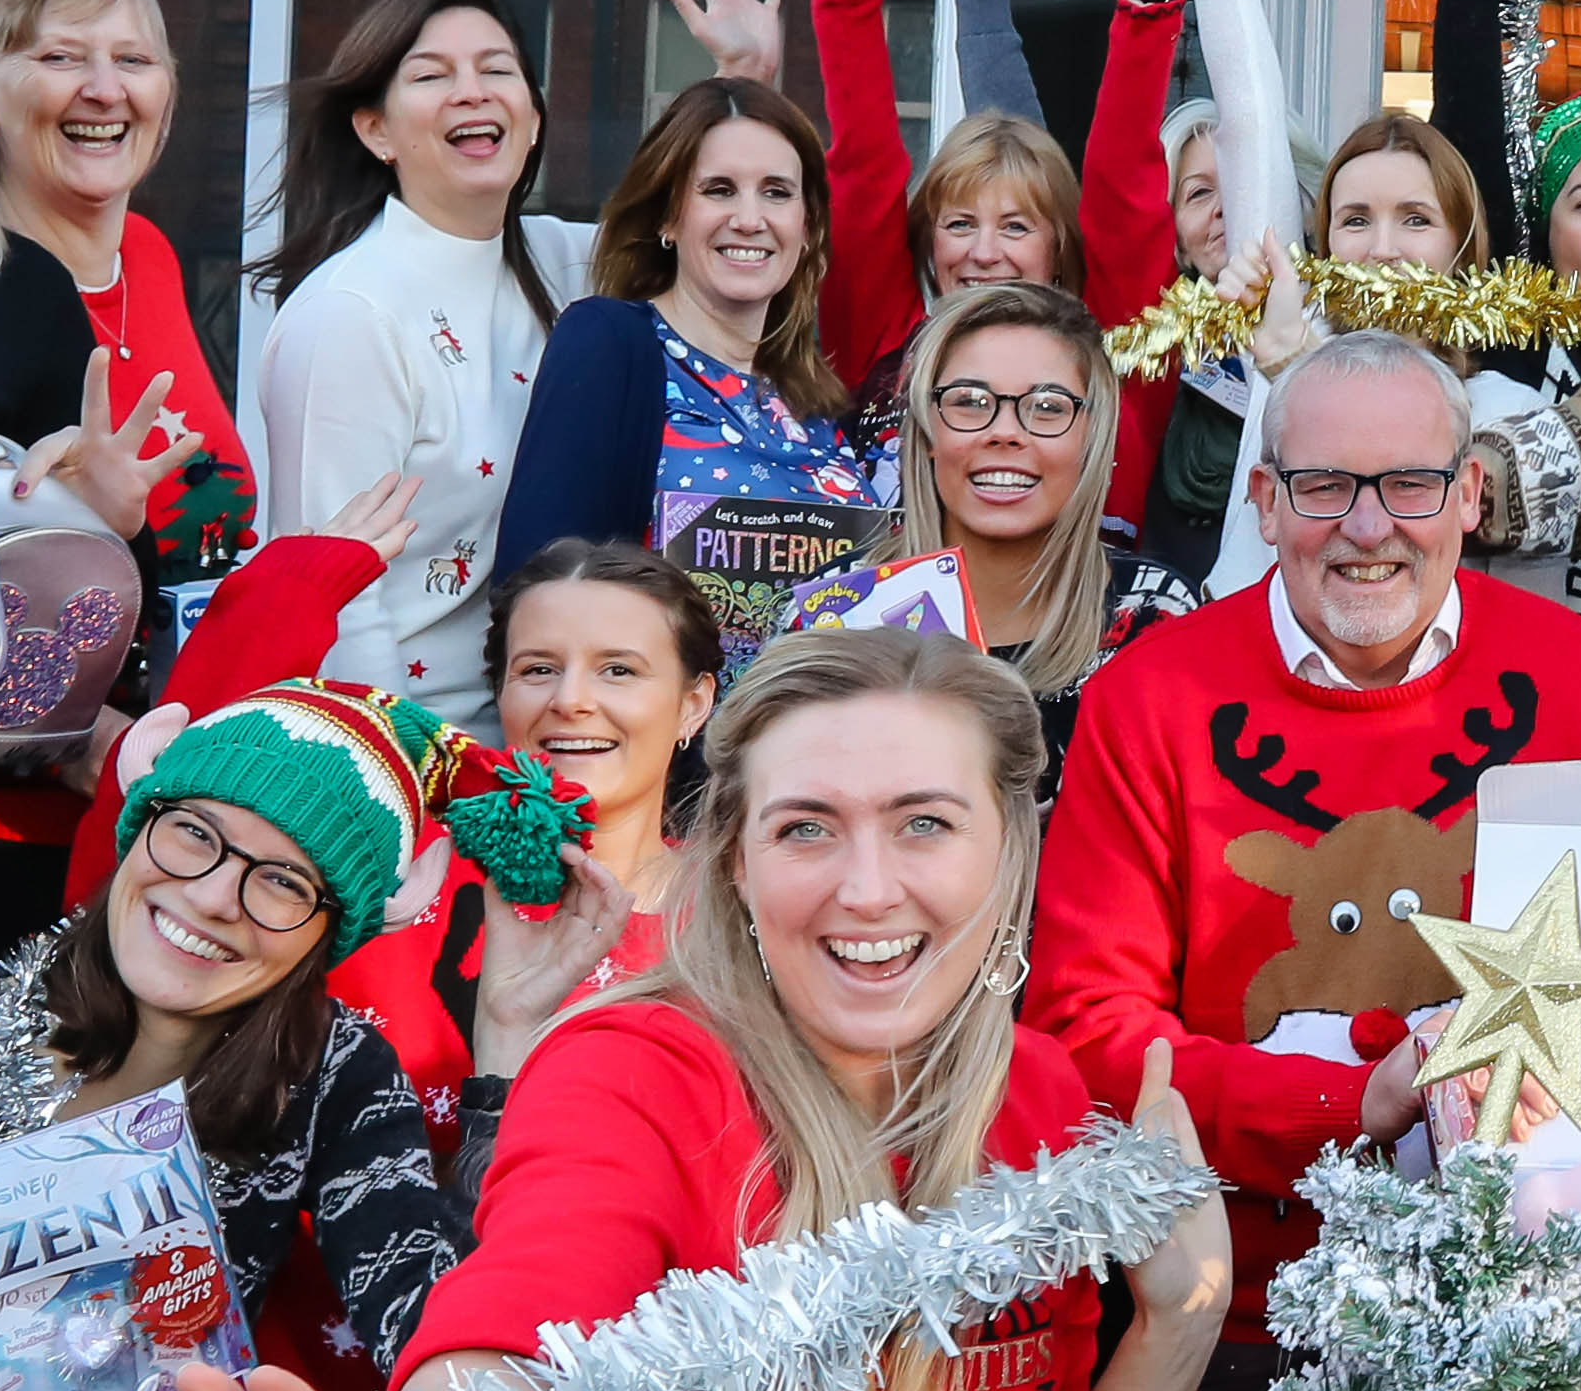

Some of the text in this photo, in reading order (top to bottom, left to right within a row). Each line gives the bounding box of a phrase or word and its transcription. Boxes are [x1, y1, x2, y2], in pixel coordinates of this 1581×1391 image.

[715, 507, 835, 530] Let's scratch and draw
[937, 556, 954, 572] 3+
[139, 1115, 181, 1145] STORY!
[123, 1162, 187, 1236] II
[169, 1250, 185, 1275] 8
[141, 1259, 217, 1304] AMAZING
[23, 1287, 50, 1305] set
[162, 1280, 212, 1317] GIFTS
